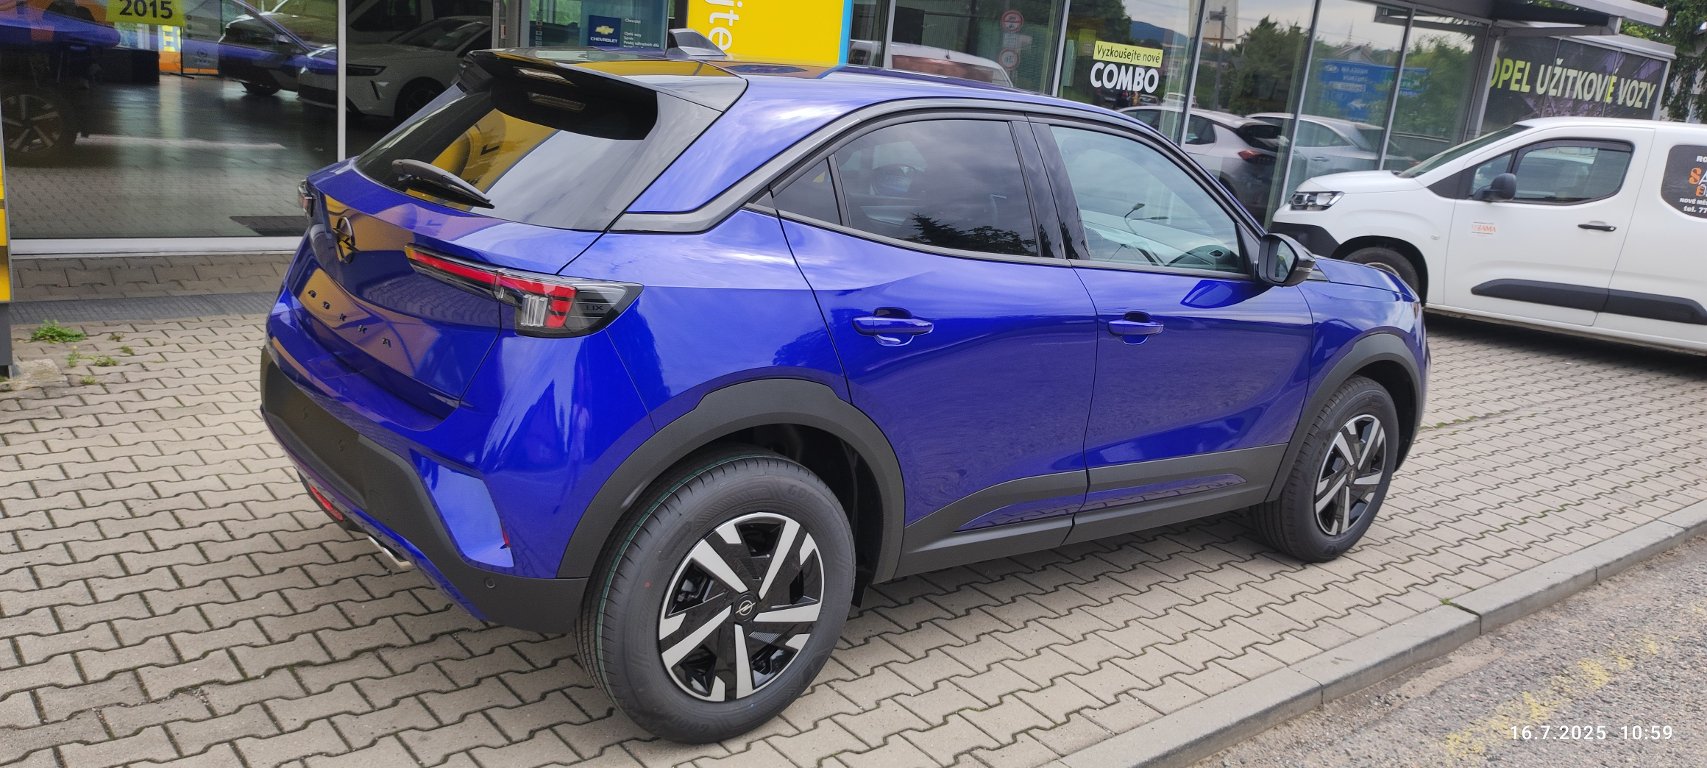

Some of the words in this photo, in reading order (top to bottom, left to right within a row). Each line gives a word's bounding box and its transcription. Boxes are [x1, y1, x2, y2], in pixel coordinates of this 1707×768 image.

[119, 0, 173, 19] 2015
[1097, 44, 1141, 62] Vyzkoušejte
[1142, 52, 1161, 63] nové
[1090, 61, 1159, 94] COMBO
[1536, 57, 1619, 104] UŽITKOVÉ
[1617, 77, 1657, 109] VOZY
